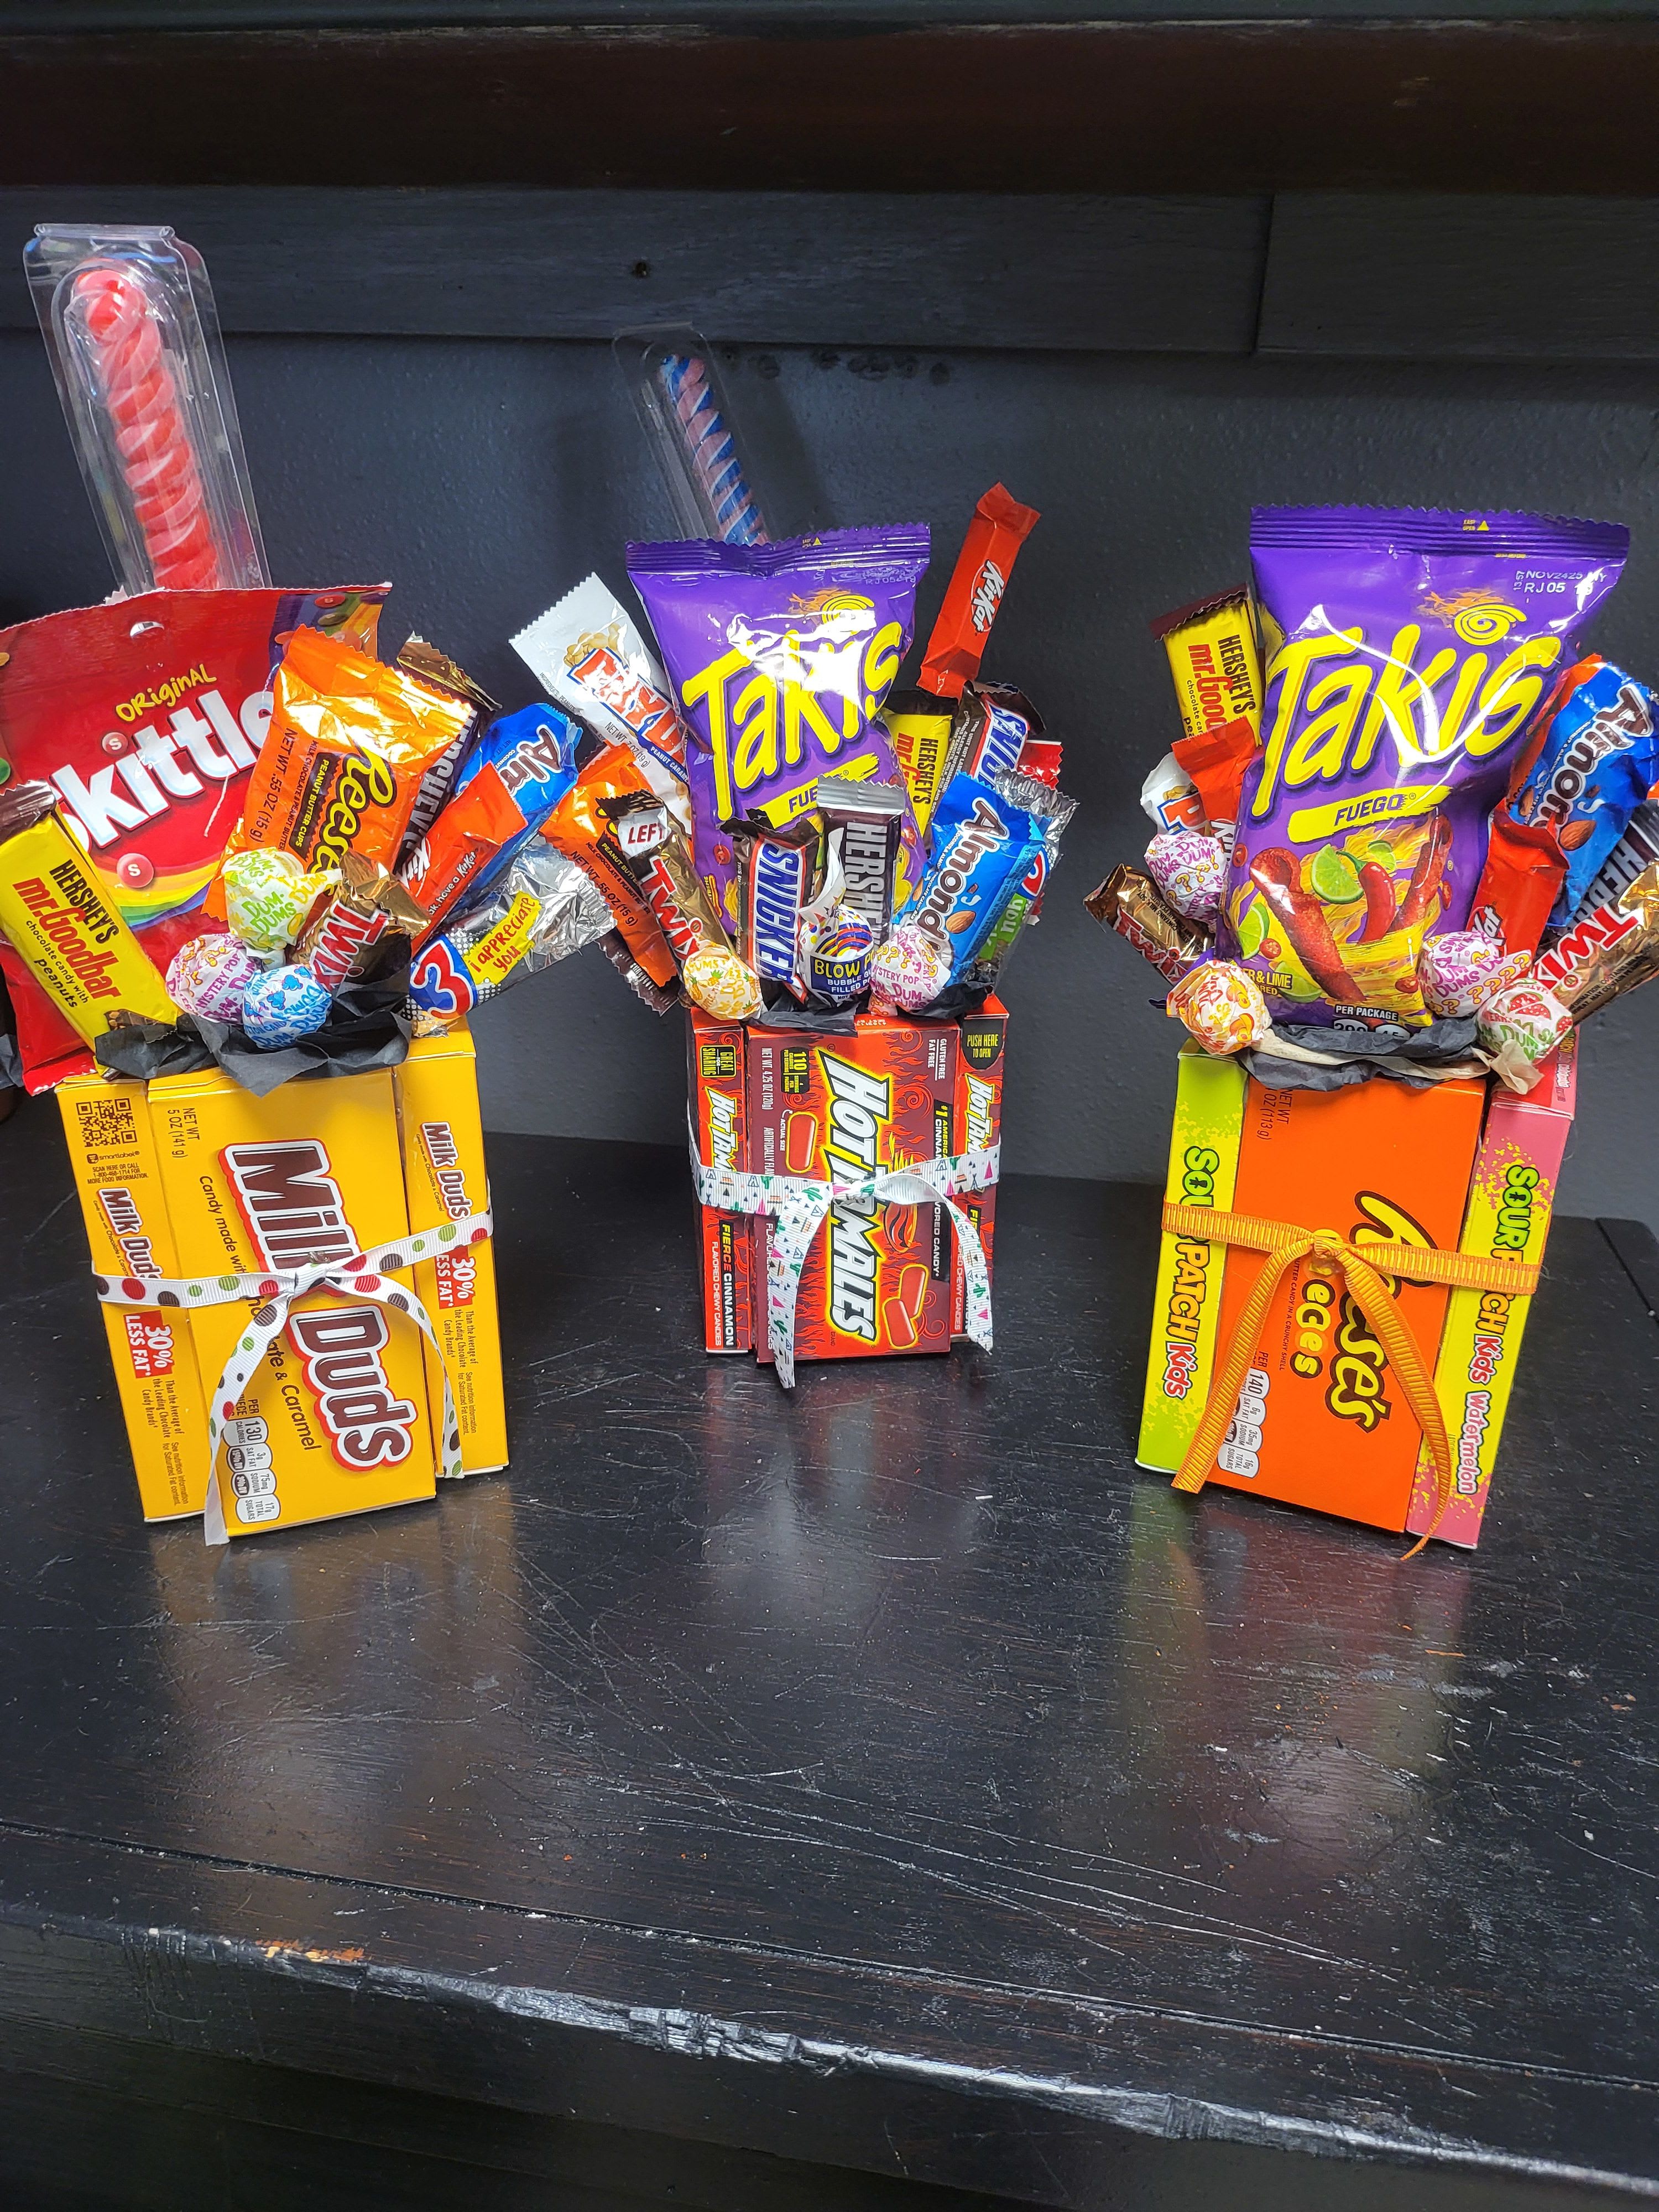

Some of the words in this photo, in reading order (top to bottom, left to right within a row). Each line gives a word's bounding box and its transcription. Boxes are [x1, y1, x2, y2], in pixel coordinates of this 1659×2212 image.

[1218, 634, 1255, 714] HERSHEY'S
[1187, 680, 1199, 719] chocolate
[1251, 624, 1561, 816] Takis
[280, 728, 298, 756] NET
[276, 755, 289, 775] WT
[499, 725, 562, 795] Alm
[650, 746, 670, 764] PEANUT
[1531, 685, 1651, 827] Almon
[50, 690, 274, 848] kittle
[312, 759, 330, 794] PEANUT
[912, 738, 938, 805] HERSHEY'S
[263, 792, 278, 812] OZ
[302, 794, 319, 826] BUTTER
[311, 745, 395, 875] Reese
[789, 786, 818, 813] FUE
[1334, 794, 1405, 826] FUEGO
[295, 823, 308, 848] CUPS
[601, 843, 620, 868] PEANUT
[570, 851, 588, 869] NET
[585, 867, 600, 883] WT
[607, 893, 622, 907] OZ
[843, 821, 886, 946] HERSHE
[917, 800, 1008, 946] Almond
[49, 859, 119, 943] HERSHEY'S
[440, 885, 455, 906] have
[251, 902, 296, 934] DUMS
[756, 843, 799, 984] SNICKER
[26, 920, 57, 960] chocolate
[55, 962, 75, 984] candy
[74, 985, 88, 1003] with
[224, 953, 241, 973] POP
[493, 946, 521, 973] you
[815, 959, 860, 978] BLOW
[34, 959, 77, 1008] peanuts
[827, 975, 862, 986] BUBBLE
[831, 983, 860, 993] FILLED
[902, 975, 920, 985] POP
[1266, 973, 1292, 988] LIME
[1335, 1005, 1354, 1015] PER
[1356, 1007, 1399, 1020] PACKAGE
[761, 1048, 773, 1058] NET
[939, 1039, 947, 1063] GLUTEN
[967, 1034, 982, 1047] PUSH
[983, 1034, 998, 1046] HERE
[979, 1048, 991, 1057] OPEN
[703, 1048, 716, 1075] SHARING
[720, 1051, 734, 1071] GREAT
[794, 1052, 807, 1071] 110
[761, 1092, 774, 1110] (120g)
[820, 1051, 891, 1156] HOT
[1264, 1093, 1277, 1107] OZ
[1279, 1089, 1293, 1108] NET
[169, 1116, 182, 1130] OZ
[183, 1108, 197, 1126] NET
[1260, 1108, 1275, 1129] (113
[1276, 1109, 1291, 1125] WT
[169, 1131, 186, 1148] (141
[187, 1127, 200, 1140] WT
[424, 1123, 458, 1166] Milk
[764, 1127, 774, 1162] ARTIFICIALLY
[1256, 1130, 1272, 1140] g)
[116, 1172, 149, 1181] INFORMATION.
[425, 1164, 435, 1187] Chocolate
[434, 1192, 444, 1211] Caramel
[440, 1170, 472, 1217] Duds
[1179, 1146, 1219, 1243] SOU
[199, 1176, 222, 1214] Candy
[215, 1218, 236, 1252] made
[1495, 1165, 1538, 1250] SOUR
[100, 1188, 142, 1234] Milk
[122, 1237, 161, 1279] Dud
[823, 1149, 884, 1342] TMALES
[722, 1224, 732, 1272] FIERCE
[452, 1258, 476, 1299] 30%
[1165, 1243, 1210, 1343] PATCH
[1288, 1285, 1297, 1305] CANDY
[466, 1311, 474, 1323] Than
[723, 1273, 733, 1346] CINNAMON
[126, 1316, 145, 1346] LESS
[444, 1319, 452, 1337] Candy
[1282, 1319, 1292, 1350] CRUNCHY
[145, 1326, 173, 1368] 30%
[458, 1342, 468, 1368] Chocolate
[1258, 1351, 1269, 1368] PER
[1468, 1334, 1503, 1385] Kids
[1164, 1340, 1195, 1400] Kids
[166, 1380, 175, 1394] Than
[292, 1308, 414, 1464] Duds
[1248, 1374, 1264, 1394] 140
[142, 1389, 152, 1405] Candy
[155, 1389, 166, 1410] Leading
[248, 1399, 259, 1413] PER
[159, 1412, 171, 1438] Chocolate
[170, 1406, 181, 1427] Average
[281, 1385, 323, 1451] Caramel
[236, 1421, 245, 1443] CALORIES
[245, 1422, 262, 1441] 130
[1238, 1424, 1247, 1446] SODIUM
[1246, 1428, 1258, 1446] 35mg
[1457, 1391, 1491, 1494] Watermelon
[1226, 1448, 1235, 1469] SUGARS
[1235, 1454, 1243, 1469] TOTAL
[179, 1475, 189, 1504] information
[251, 1473, 260, 1493] SODIUM
[260, 1474, 270, 1489] 75mg
[246, 1500, 255, 1520] SUGARS
